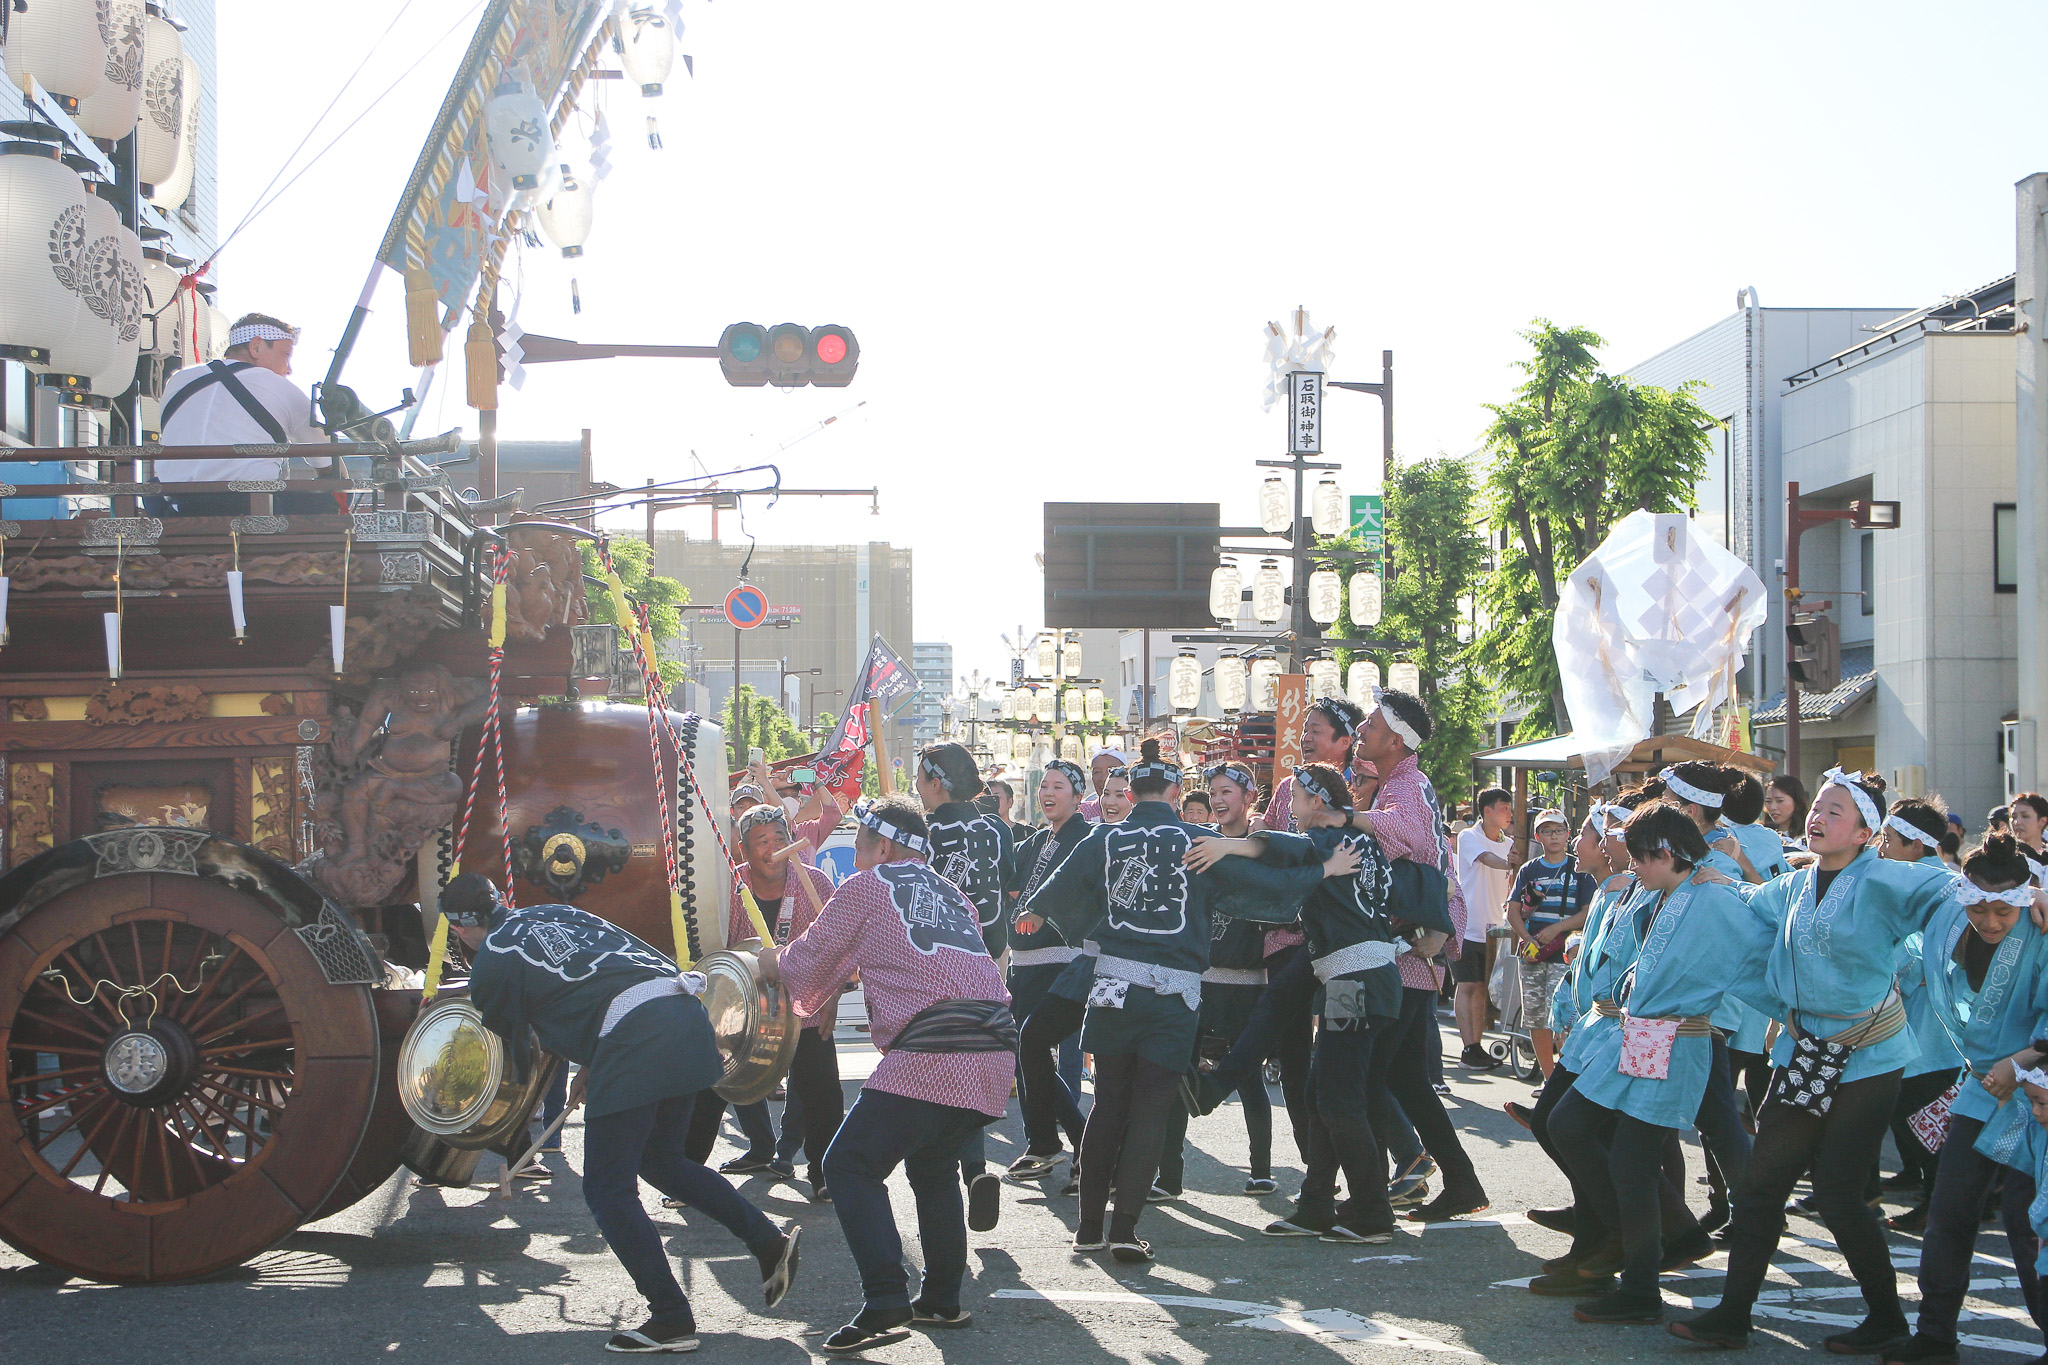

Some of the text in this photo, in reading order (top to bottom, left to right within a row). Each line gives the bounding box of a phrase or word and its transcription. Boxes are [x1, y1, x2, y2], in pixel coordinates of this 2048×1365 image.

[1300, 379, 1316, 449] 石取御神事
